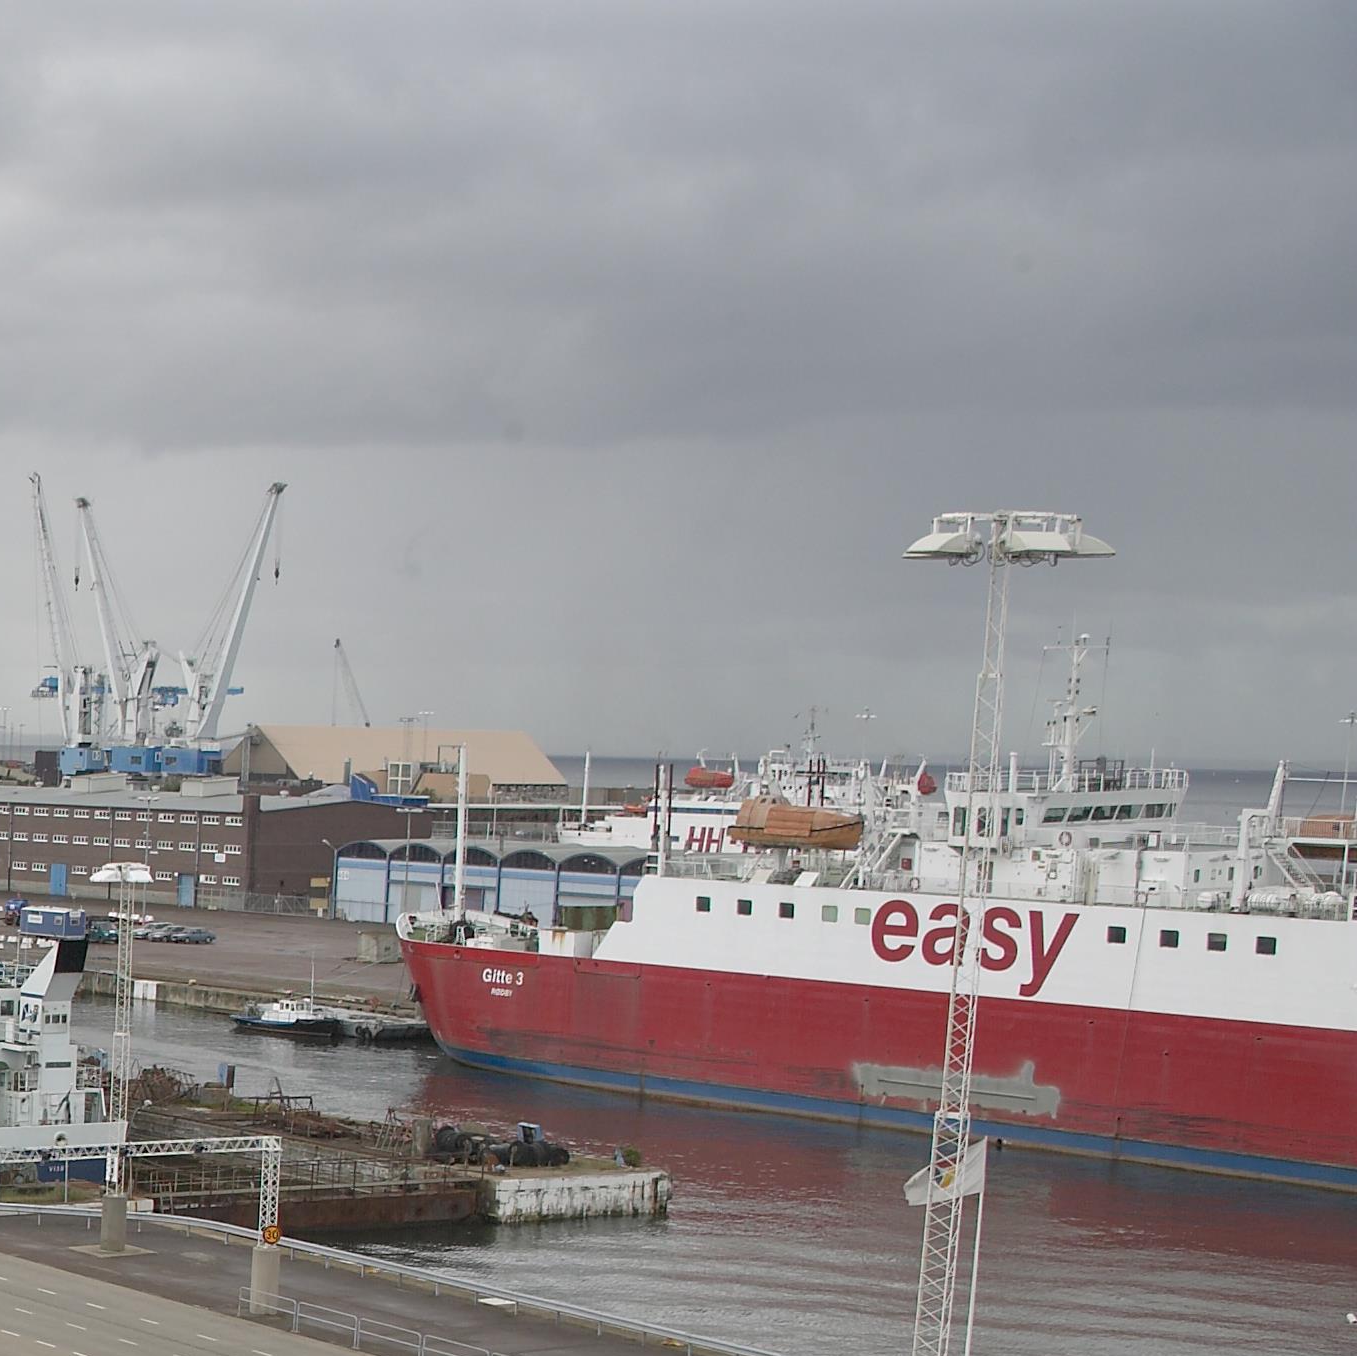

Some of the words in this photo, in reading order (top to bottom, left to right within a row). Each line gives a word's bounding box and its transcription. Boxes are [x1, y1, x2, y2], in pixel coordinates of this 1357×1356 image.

[482, 968, 513, 984] Gitte
[515, 971, 524, 985] 3
[871, 899, 1080, 997] easy
